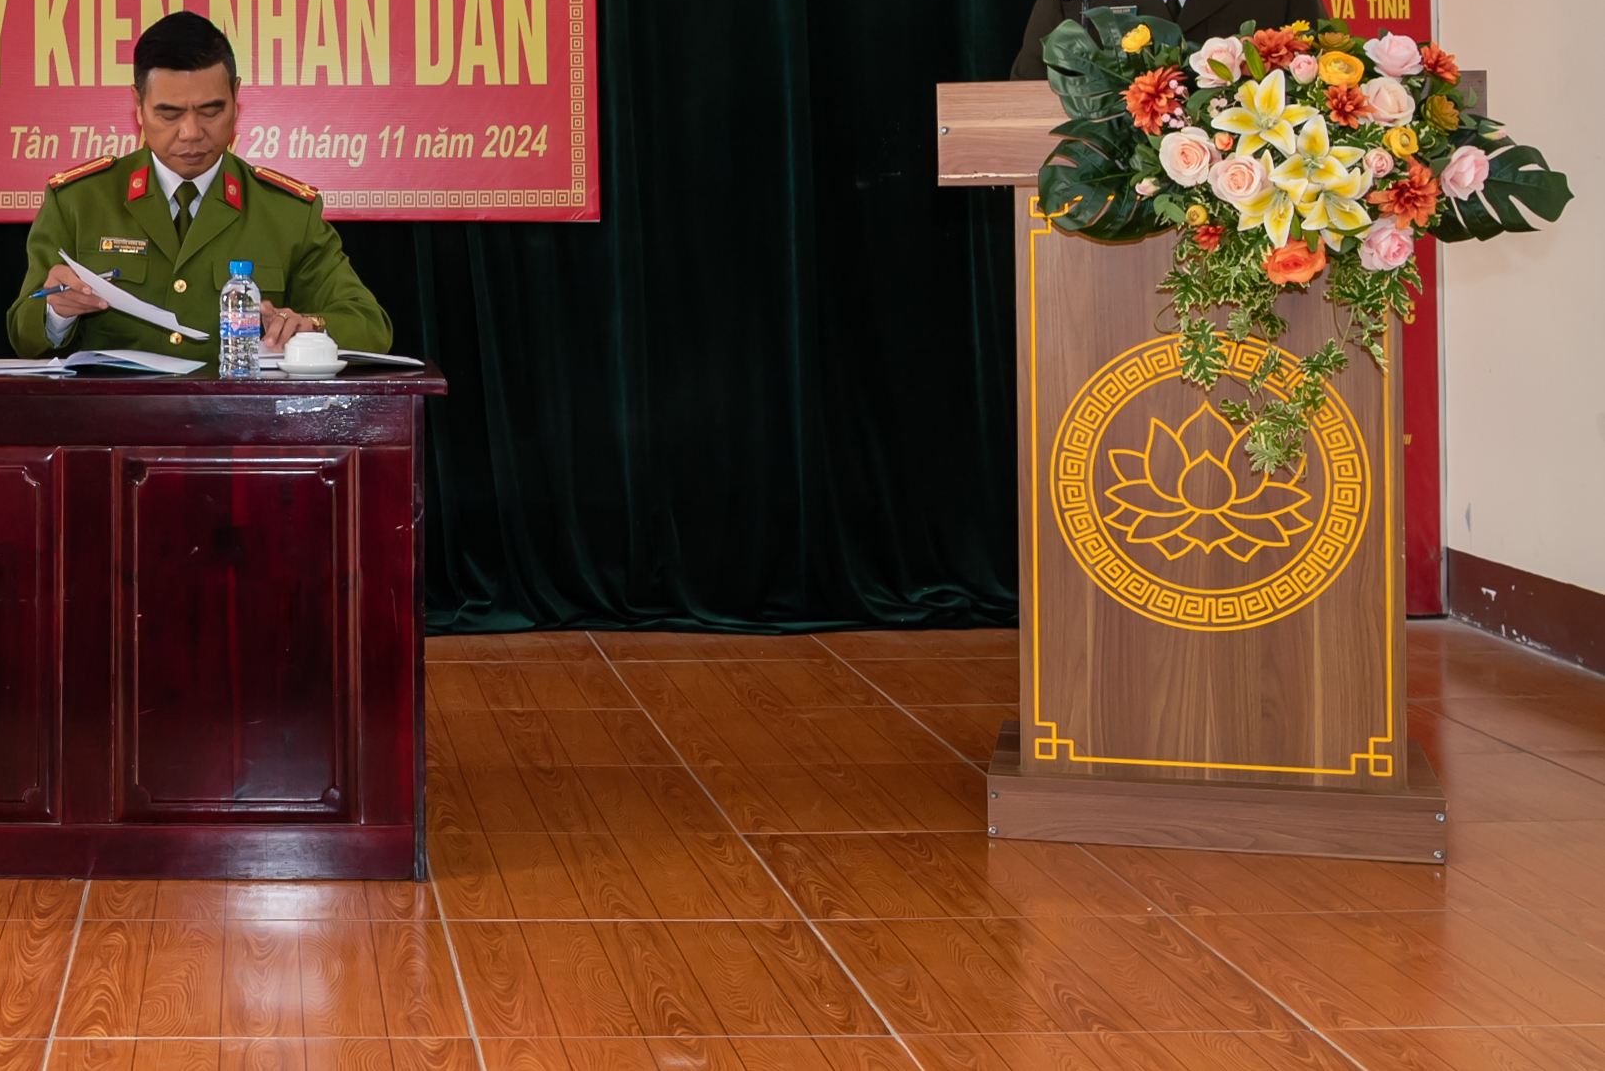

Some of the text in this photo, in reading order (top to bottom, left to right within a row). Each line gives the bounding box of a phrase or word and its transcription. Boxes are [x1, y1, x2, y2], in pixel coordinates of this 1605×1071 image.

[11, 126, 59, 159] Tân
[71, 126, 146, 159] Thàn
[247, 126, 281, 159] 28
[288, 125, 368, 167] tháng
[378, 125, 406, 158] 11
[414, 127, 474, 158] năm
[481, 124, 548, 158] 2024
